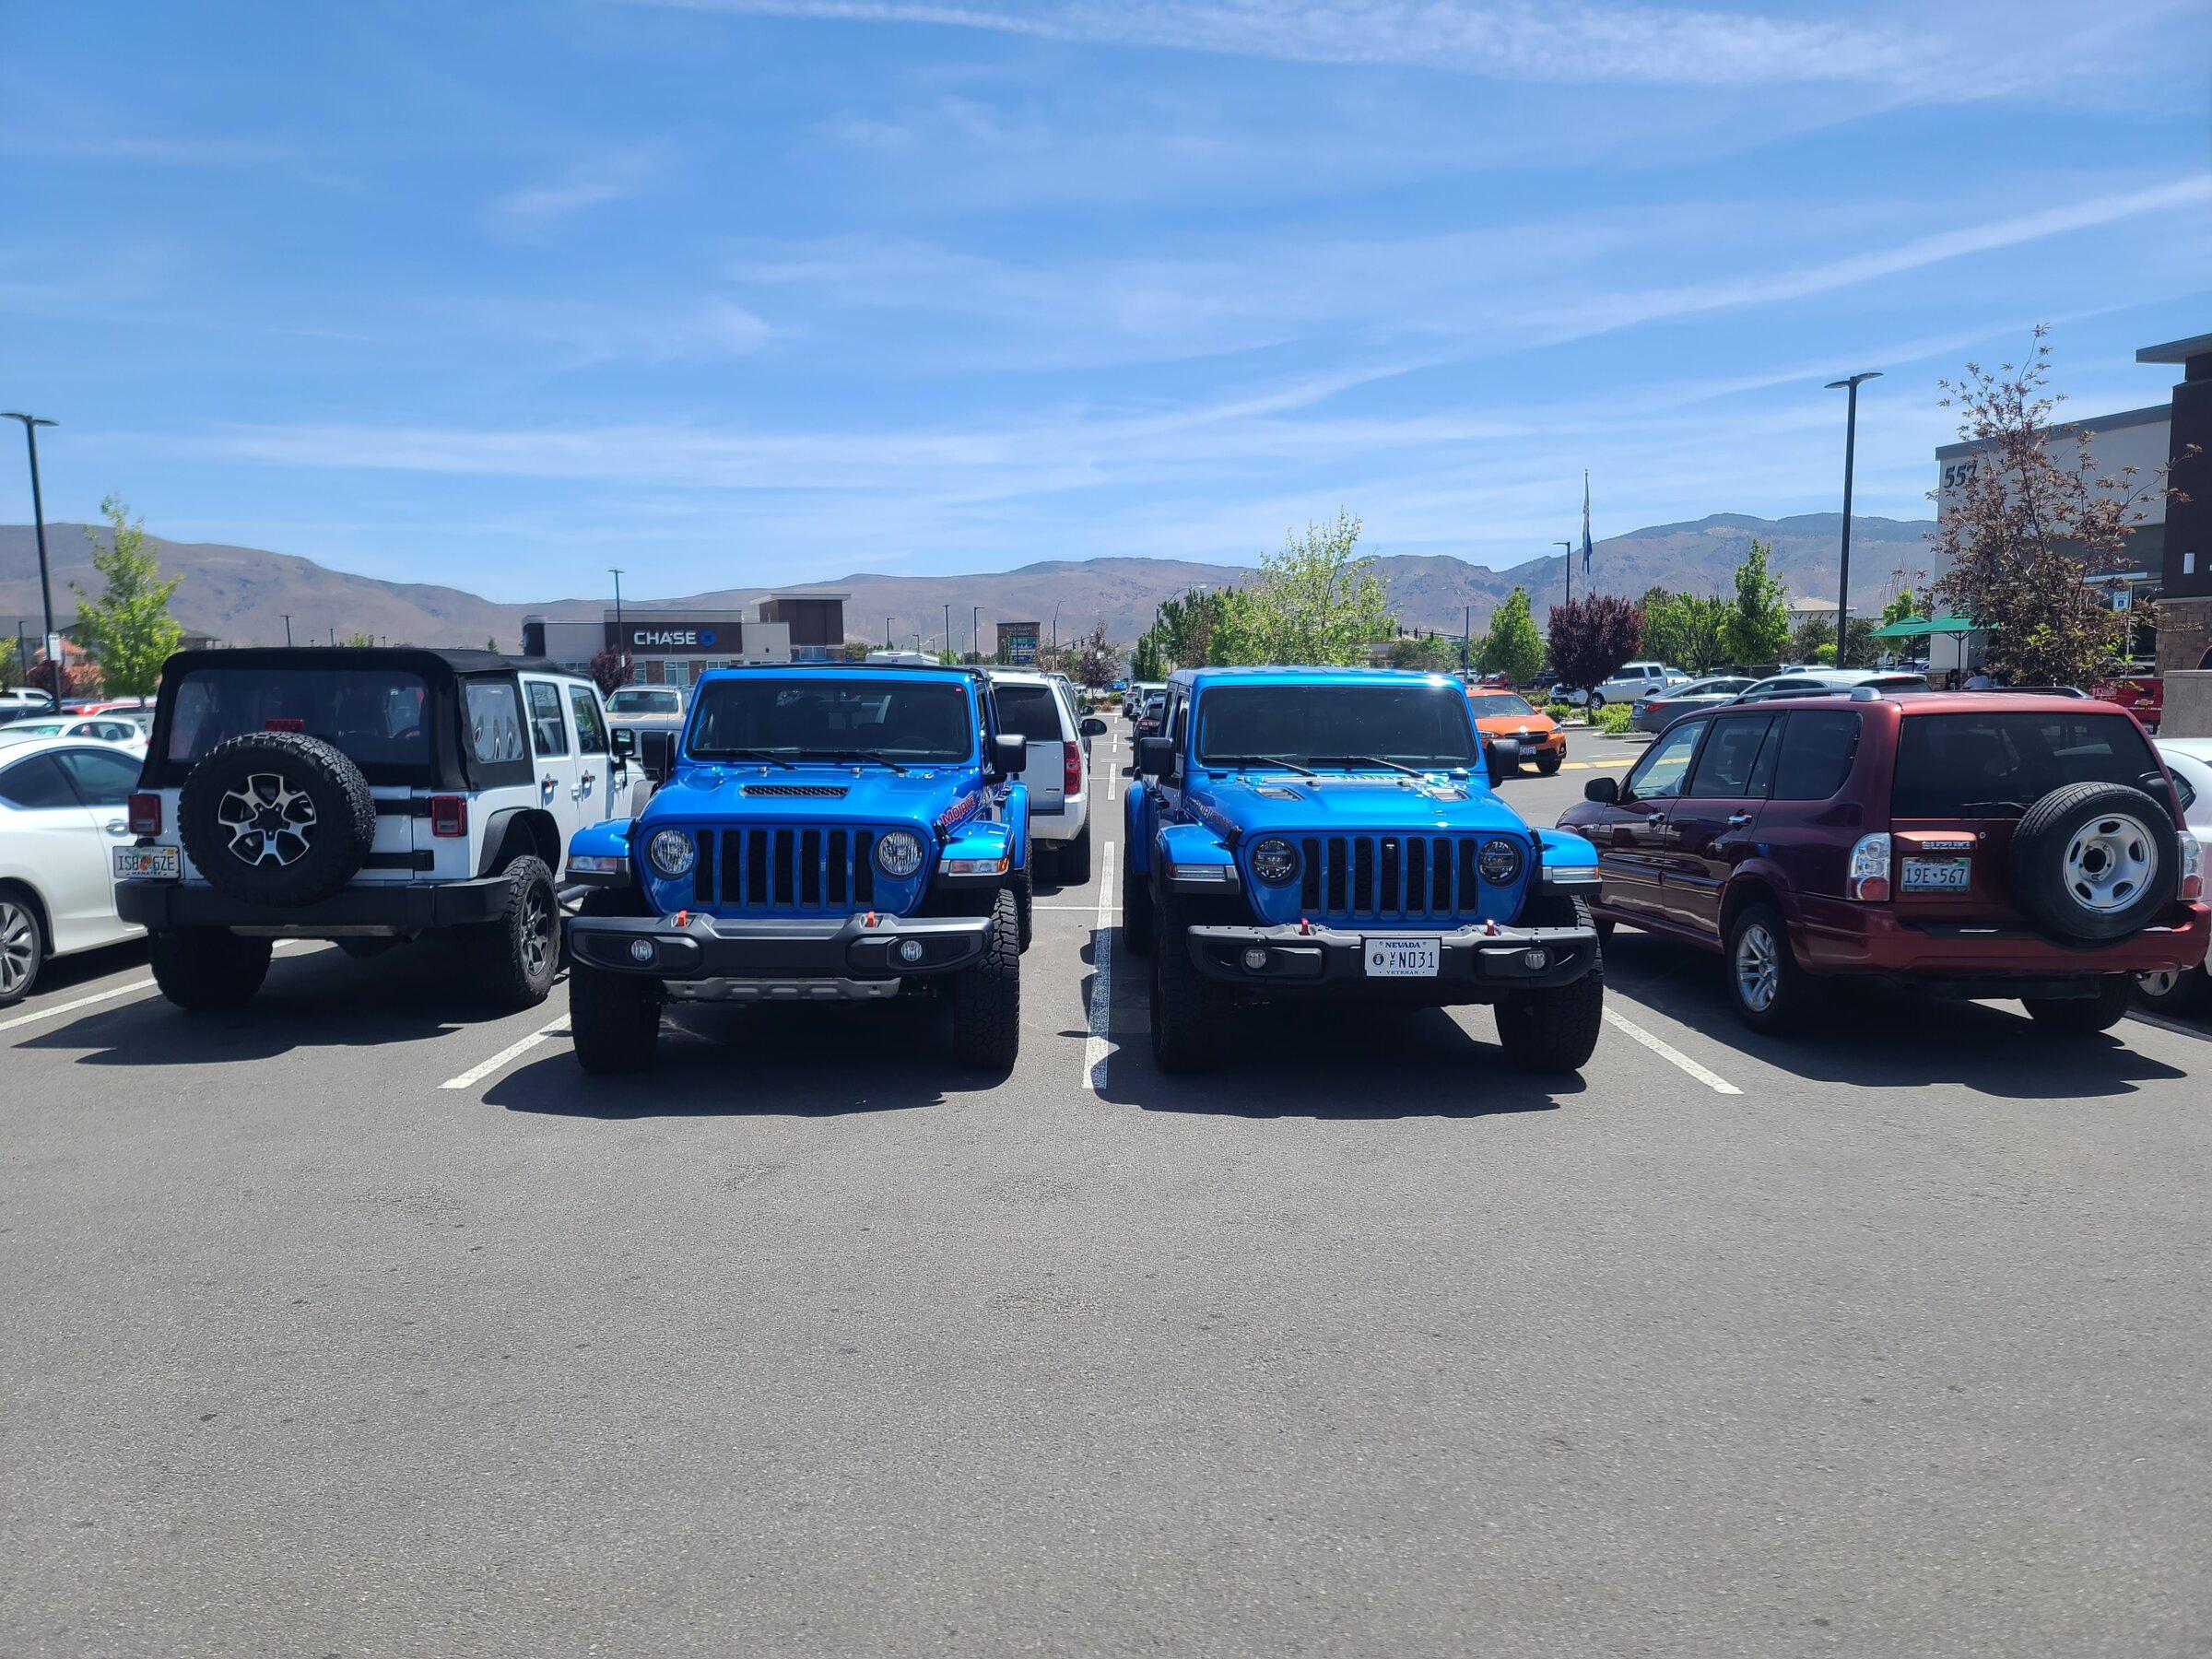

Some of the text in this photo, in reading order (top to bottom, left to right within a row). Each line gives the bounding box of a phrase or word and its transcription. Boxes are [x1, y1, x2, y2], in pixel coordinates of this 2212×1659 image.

[1943, 460, 1979, 489] 557
[633, 631, 698, 645] CHASE
[940, 794, 976, 827] MOJAVE
[1922, 841, 1971, 850] SUZUKI
[1904, 867, 1965, 884] 19E 567
